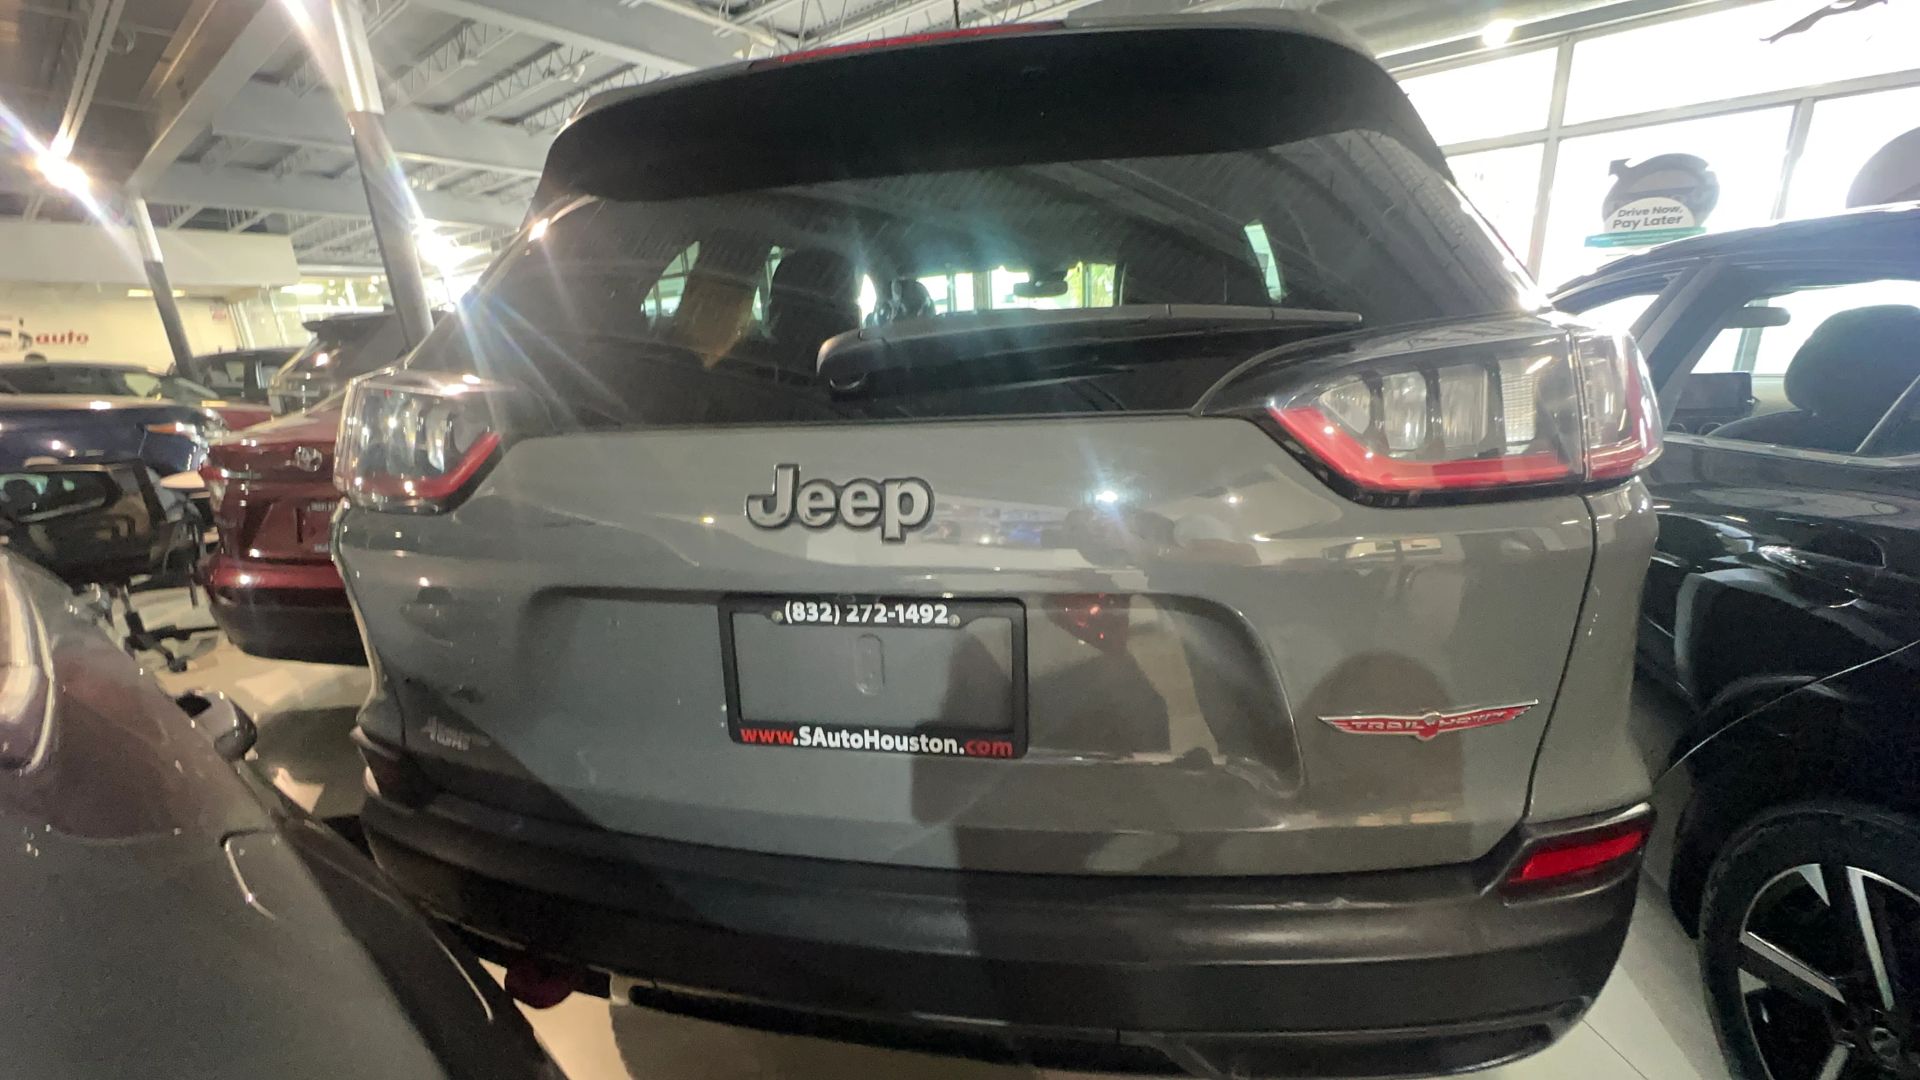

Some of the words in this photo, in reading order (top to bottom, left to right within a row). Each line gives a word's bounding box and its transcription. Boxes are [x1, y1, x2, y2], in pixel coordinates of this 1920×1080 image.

[1617, 208, 1650, 218] Drive
[1652, 206, 1683, 214] Now,
[1613, 219, 1640, 230] Pay
[1644, 215, 1683, 226] Later
[36, 330, 89, 344] auto
[745, 464, 934, 543] Jeep
[785, 600, 840, 625] (832)
[846, 603, 948, 624] 272-1492
[740, 726, 1013, 757] www.SAutoHouston.com
